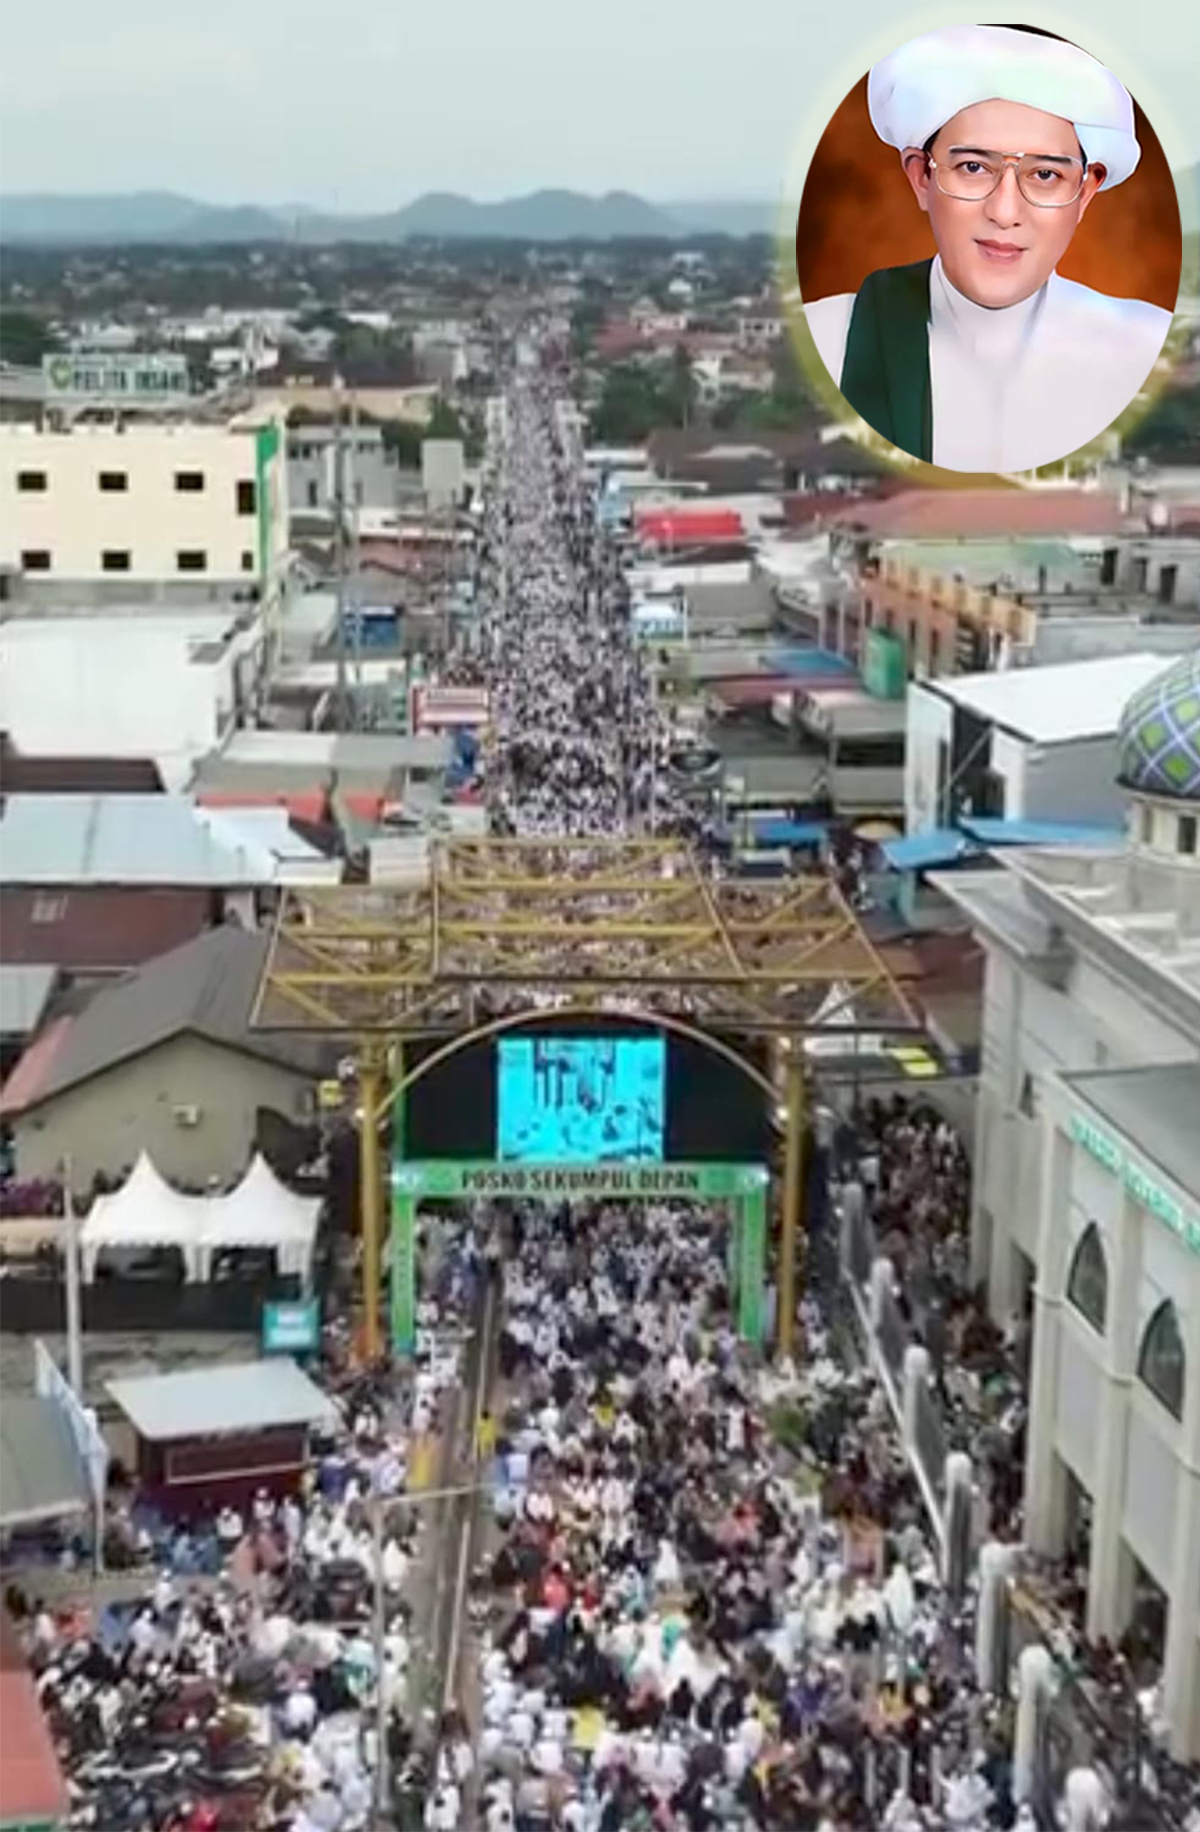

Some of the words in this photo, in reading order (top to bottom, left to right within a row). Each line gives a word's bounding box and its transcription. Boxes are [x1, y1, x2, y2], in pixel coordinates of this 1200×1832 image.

[461, 1168, 526, 1190] POSKO
[530, 1168, 633, 1190] SEKUMPUL
[640, 1168, 699, 1190] DEPAN
